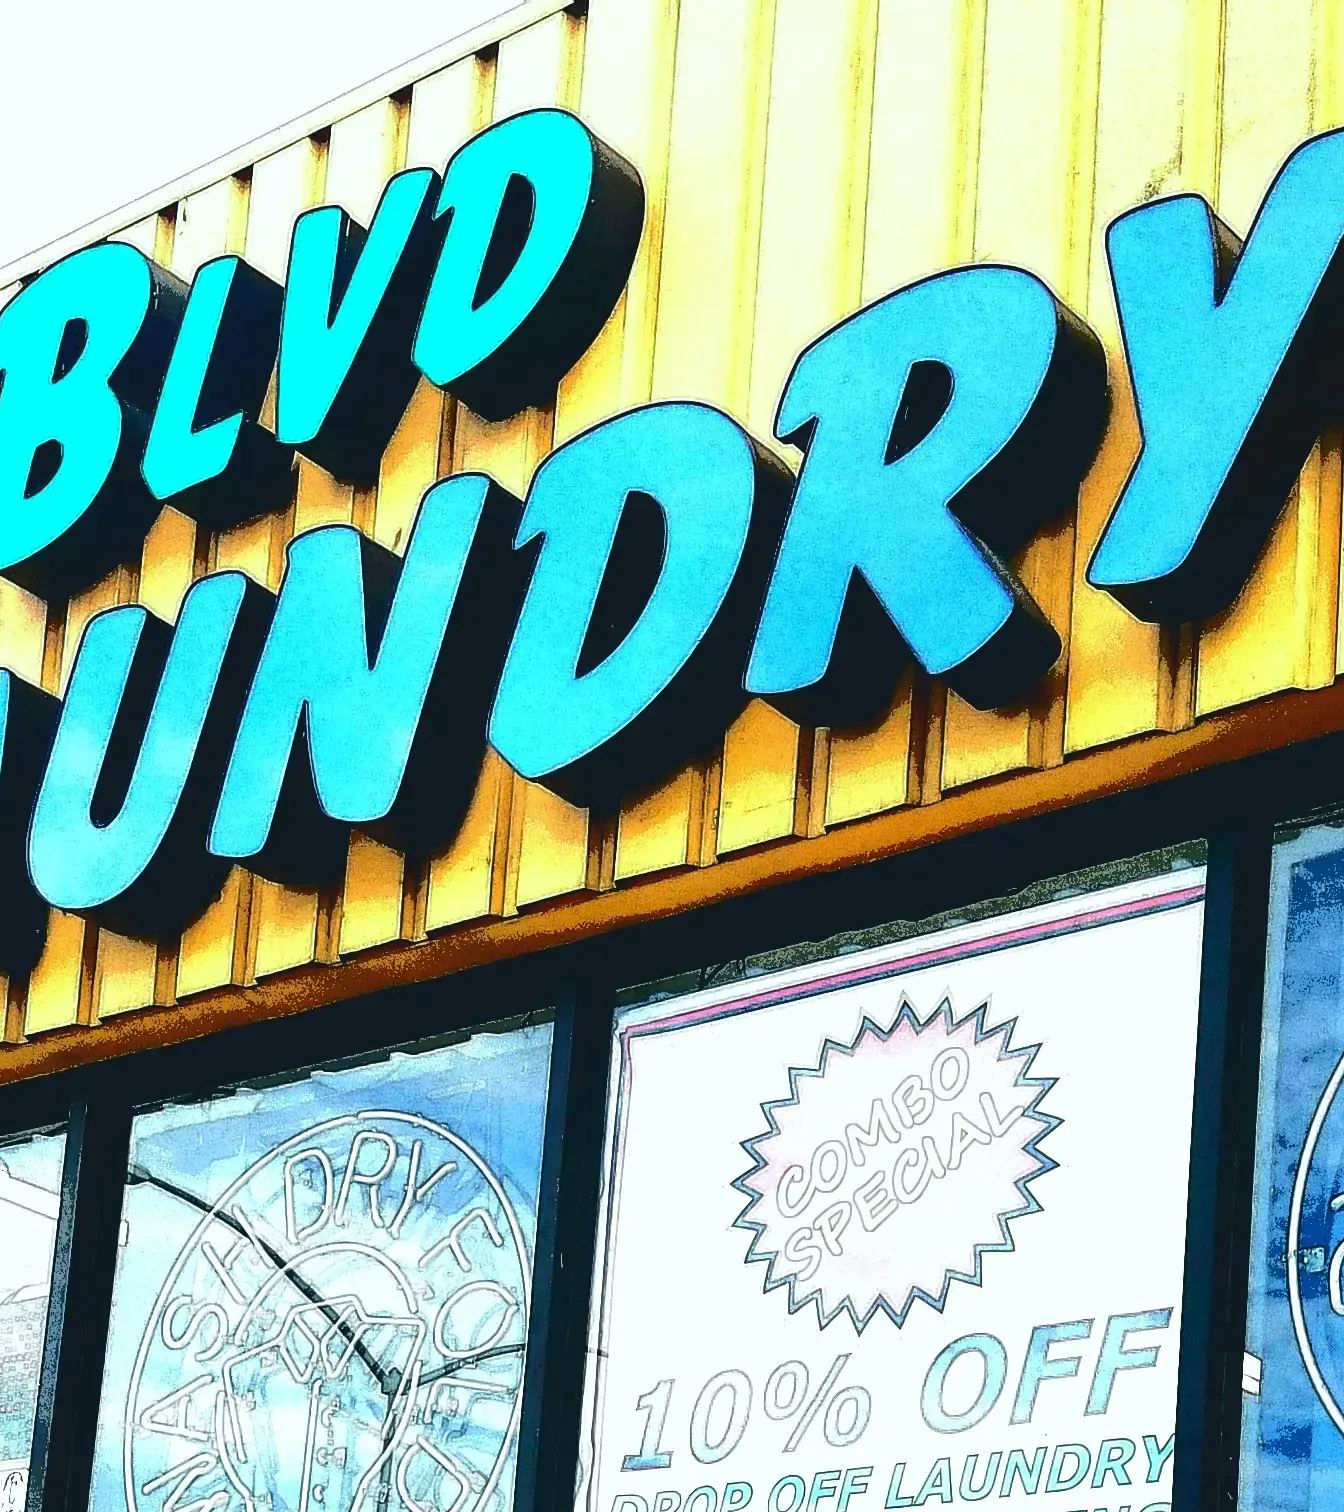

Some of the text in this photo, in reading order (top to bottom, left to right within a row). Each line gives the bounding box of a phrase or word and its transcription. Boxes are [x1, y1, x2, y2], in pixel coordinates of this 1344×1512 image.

[283, 1129, 458, 1245] DRY
[774, 1046, 972, 1219] COMBO
[782, 1090, 1029, 1282] SPECIAL
[620, 1305, 1175, 1473] 10% OFF
[884, 1431, 1176, 1509] LAUNDRY
